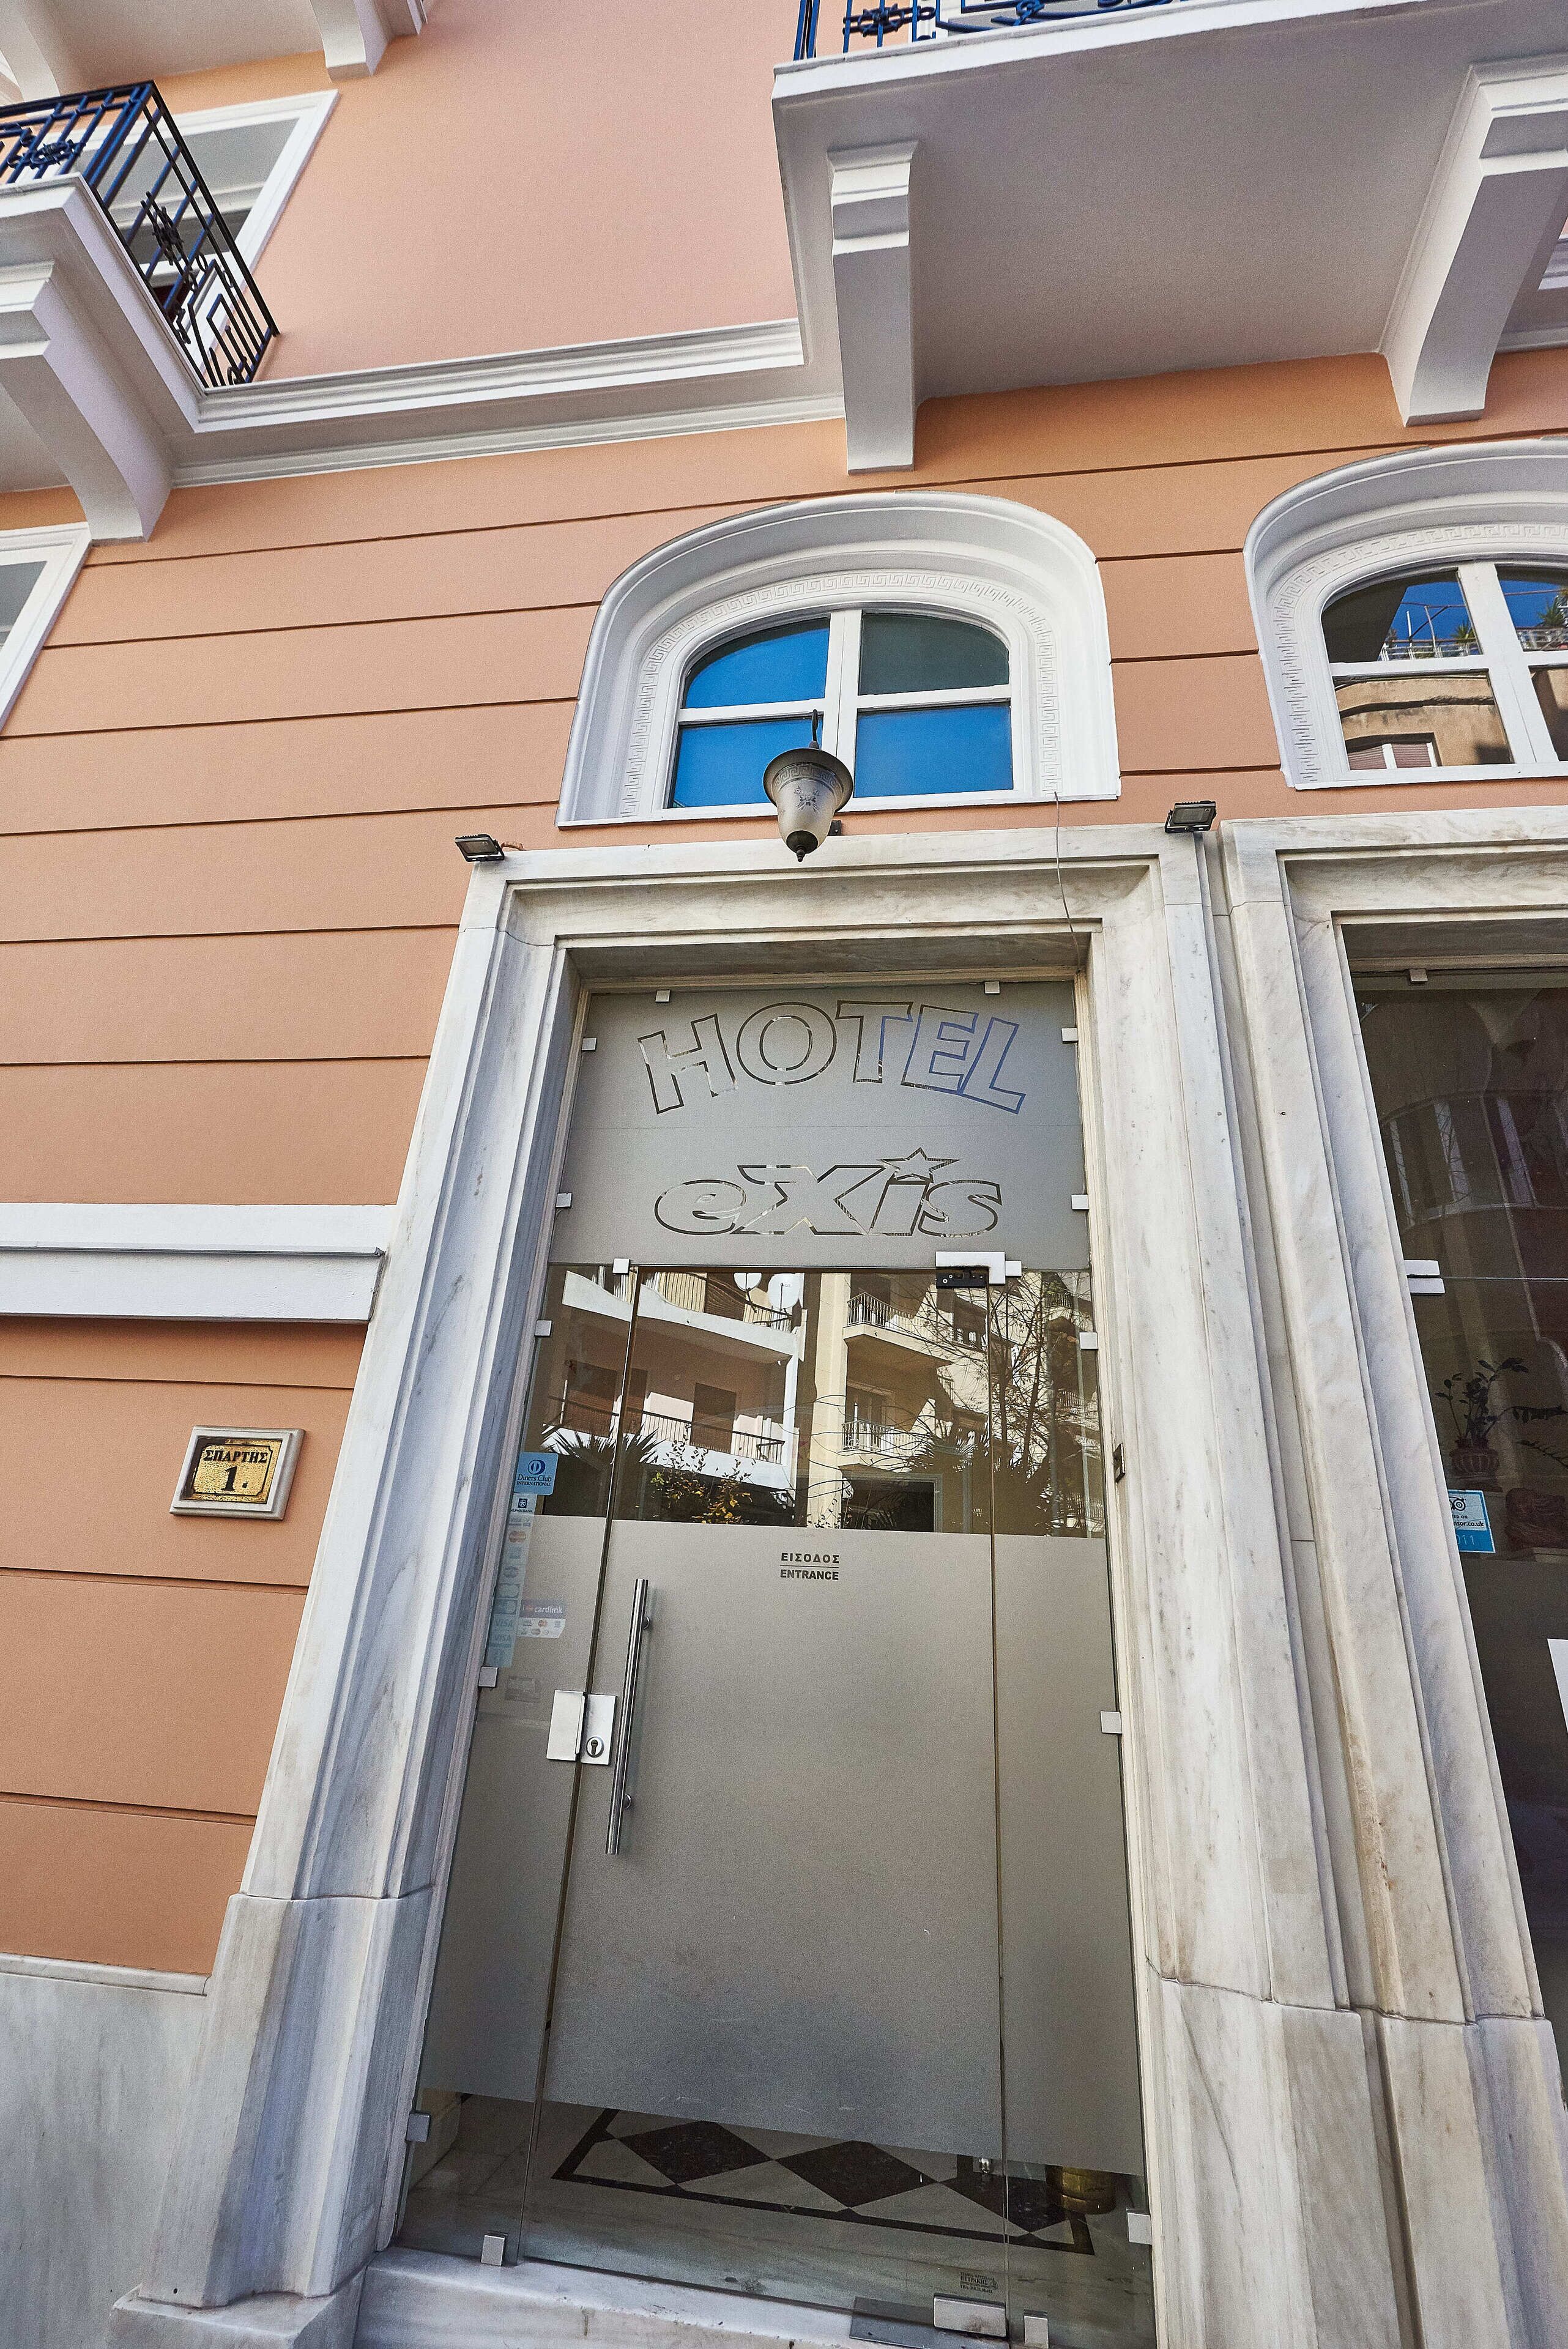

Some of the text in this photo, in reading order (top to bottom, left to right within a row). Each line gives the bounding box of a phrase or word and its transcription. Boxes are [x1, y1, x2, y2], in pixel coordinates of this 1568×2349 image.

[637, 1000, 1027, 1115] HOTEL
[203, 1450, 268, 1463] ΣΠΑΡΤΗΣ
[781, 1553, 839, 1564] ΕΙΣΟΔΟΣ
[780, 1569, 839, 1580] ENTRANCE
